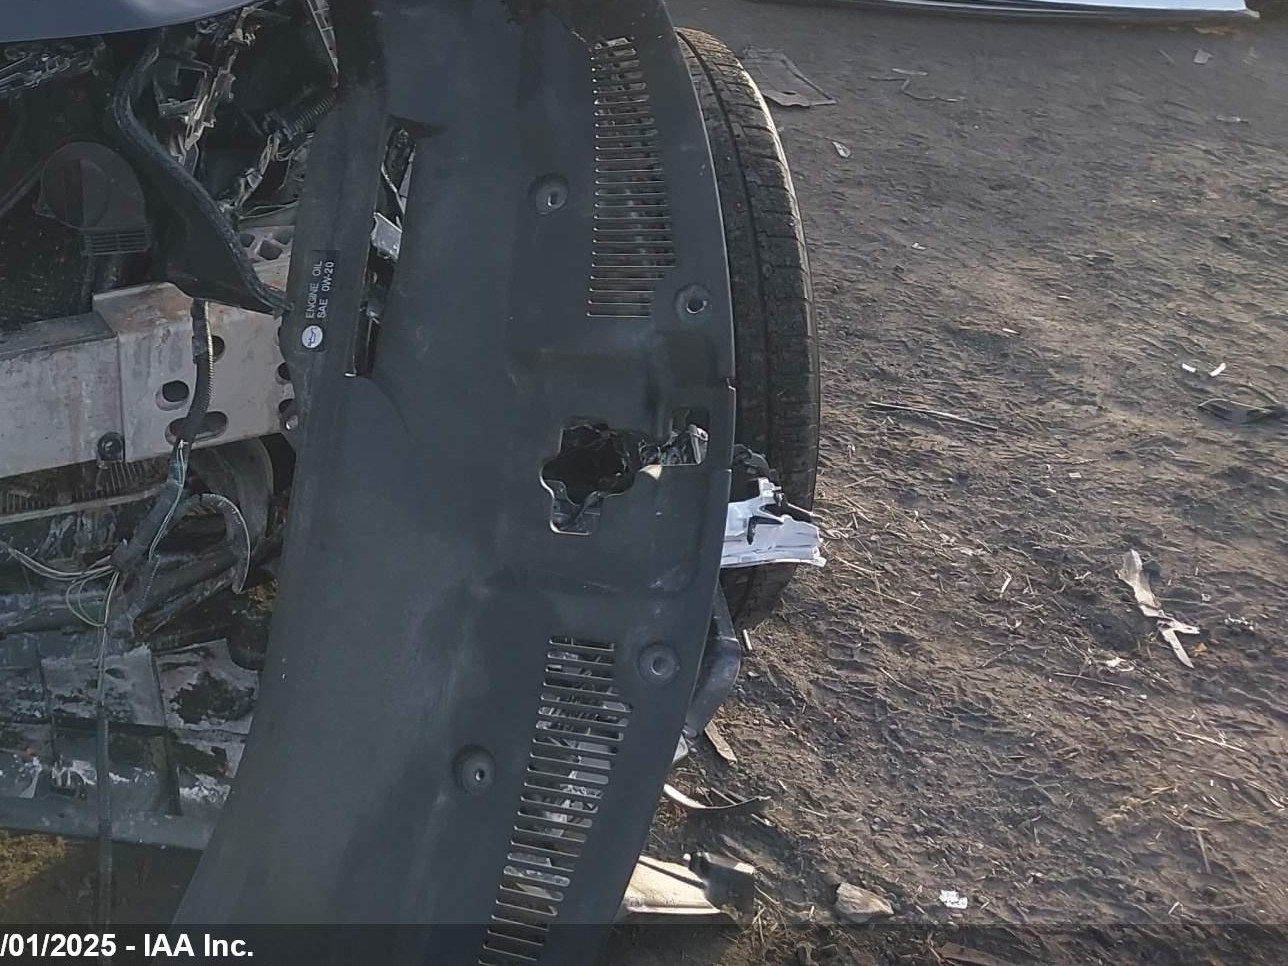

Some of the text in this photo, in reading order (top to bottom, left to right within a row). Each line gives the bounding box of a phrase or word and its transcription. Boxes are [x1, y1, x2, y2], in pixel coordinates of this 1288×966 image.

[305, 260, 324, 319] ENGINE OIL
[316, 261, 335, 319] SAE 0W-20
